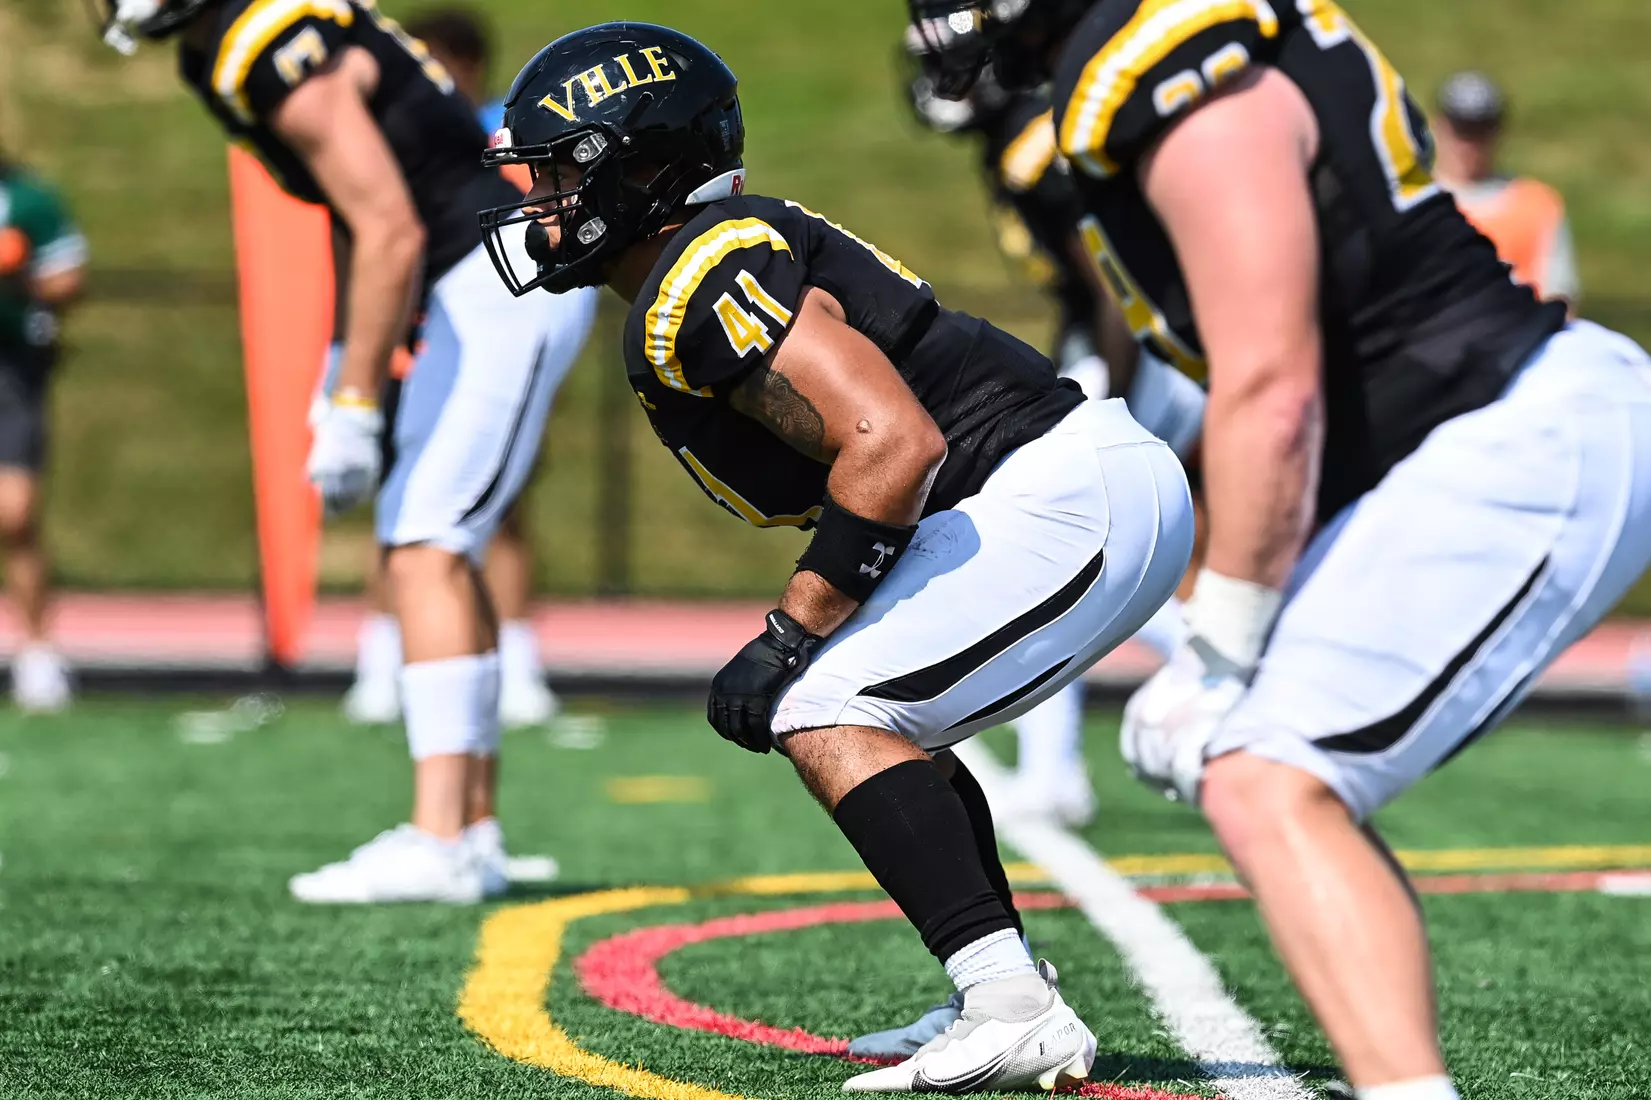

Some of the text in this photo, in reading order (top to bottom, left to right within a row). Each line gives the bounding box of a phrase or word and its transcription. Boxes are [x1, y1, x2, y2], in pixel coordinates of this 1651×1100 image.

[537, 46, 676, 122] VILLE
[712, 269, 793, 358] 41
[1039, 1022, 1078, 1056] VPOR
